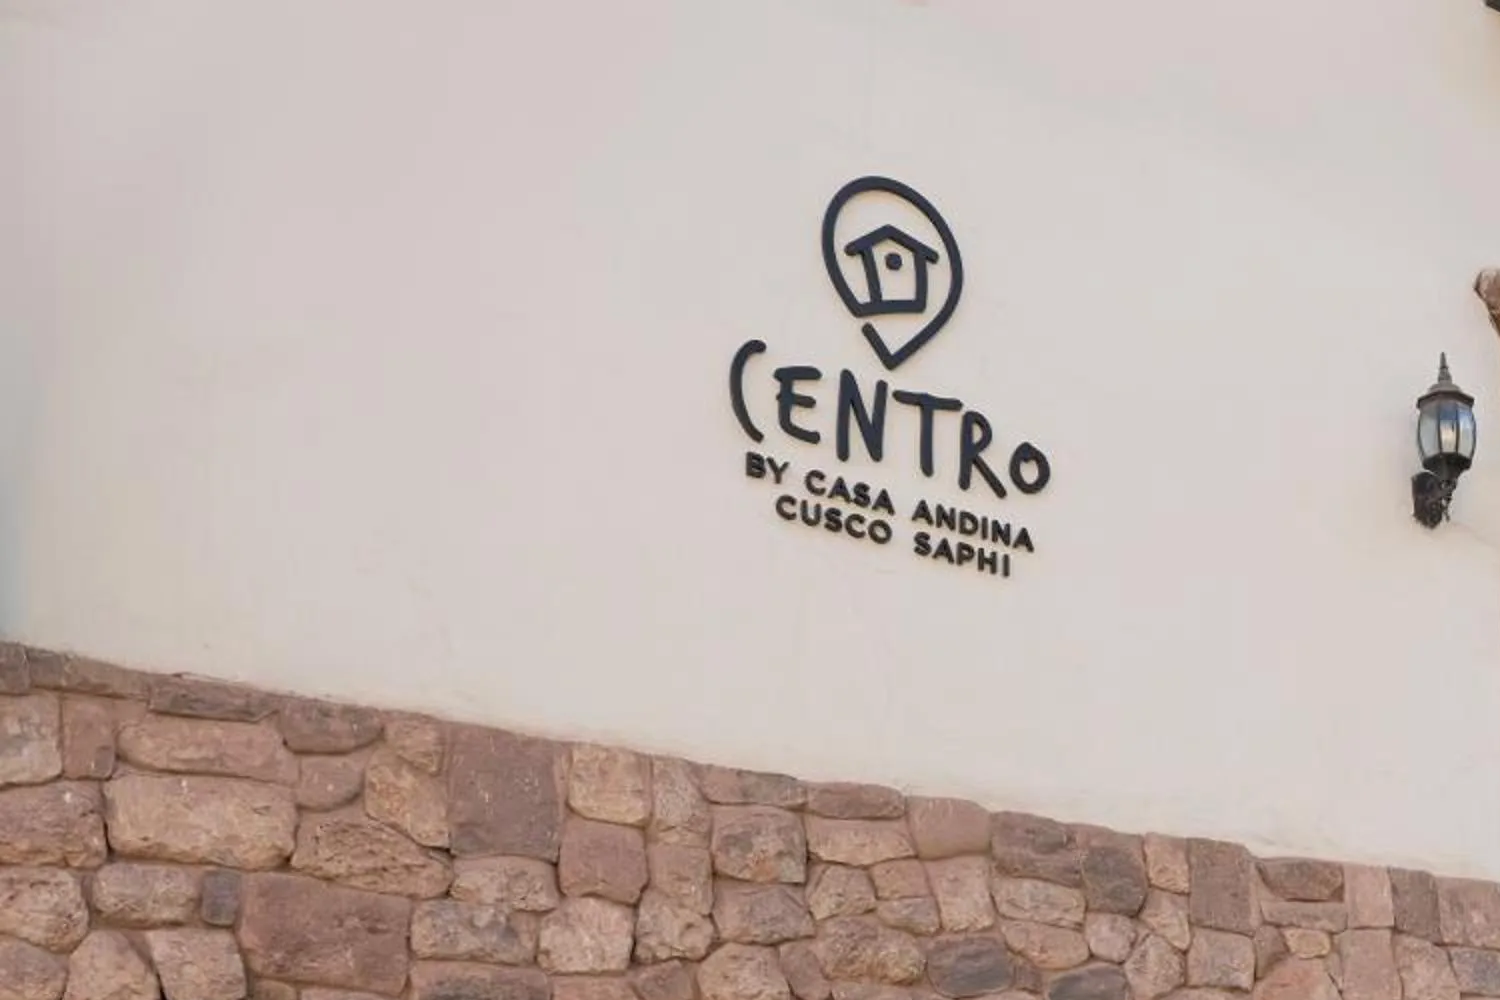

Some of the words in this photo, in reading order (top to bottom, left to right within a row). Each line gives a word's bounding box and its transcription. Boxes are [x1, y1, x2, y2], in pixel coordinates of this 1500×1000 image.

[729, 339, 1051, 499] CENTRO
[746, 452, 790, 485] BY
[805, 469, 895, 515] CASA
[911, 499, 1034, 552] ANDINA
[775, 495, 893, 544] CUSCO
[914, 532, 1010, 577] SAPHI
